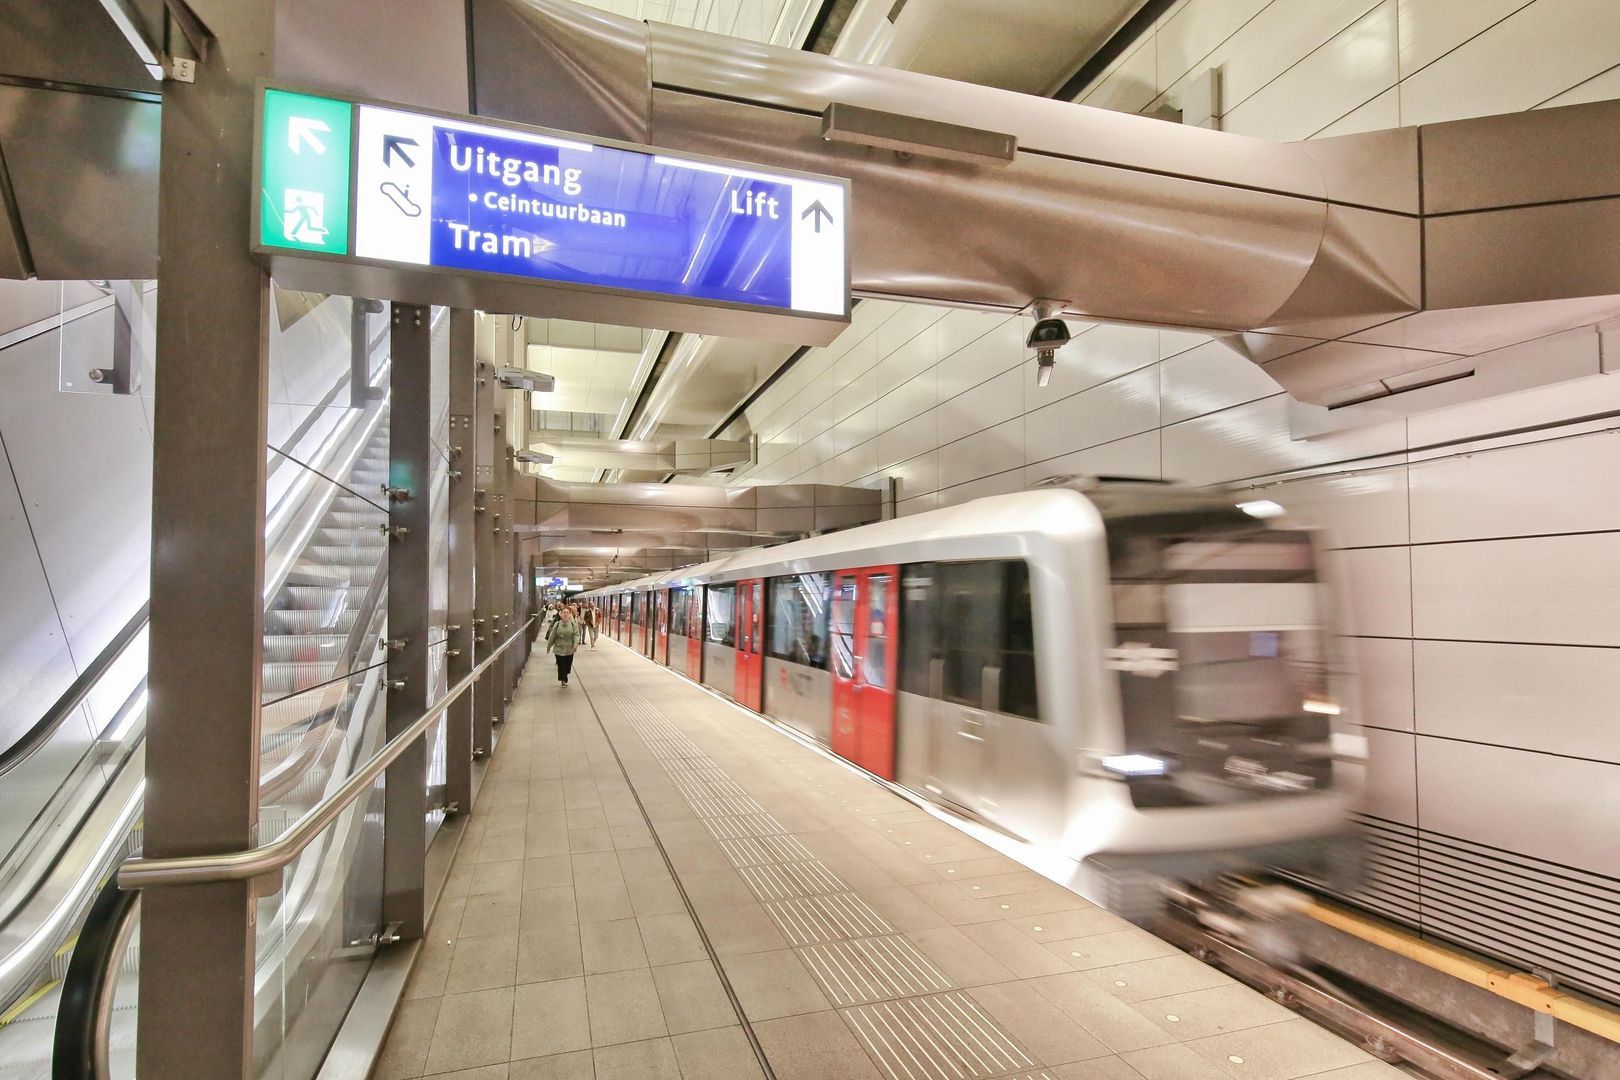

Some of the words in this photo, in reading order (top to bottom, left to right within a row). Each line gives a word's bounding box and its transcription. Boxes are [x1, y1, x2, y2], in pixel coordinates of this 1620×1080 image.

[450, 144, 582, 195] Uitgang
[483, 192, 626, 227] Ceintuurbaan
[731, 190, 779, 219] Lift
[448, 223, 531, 257] Tram
